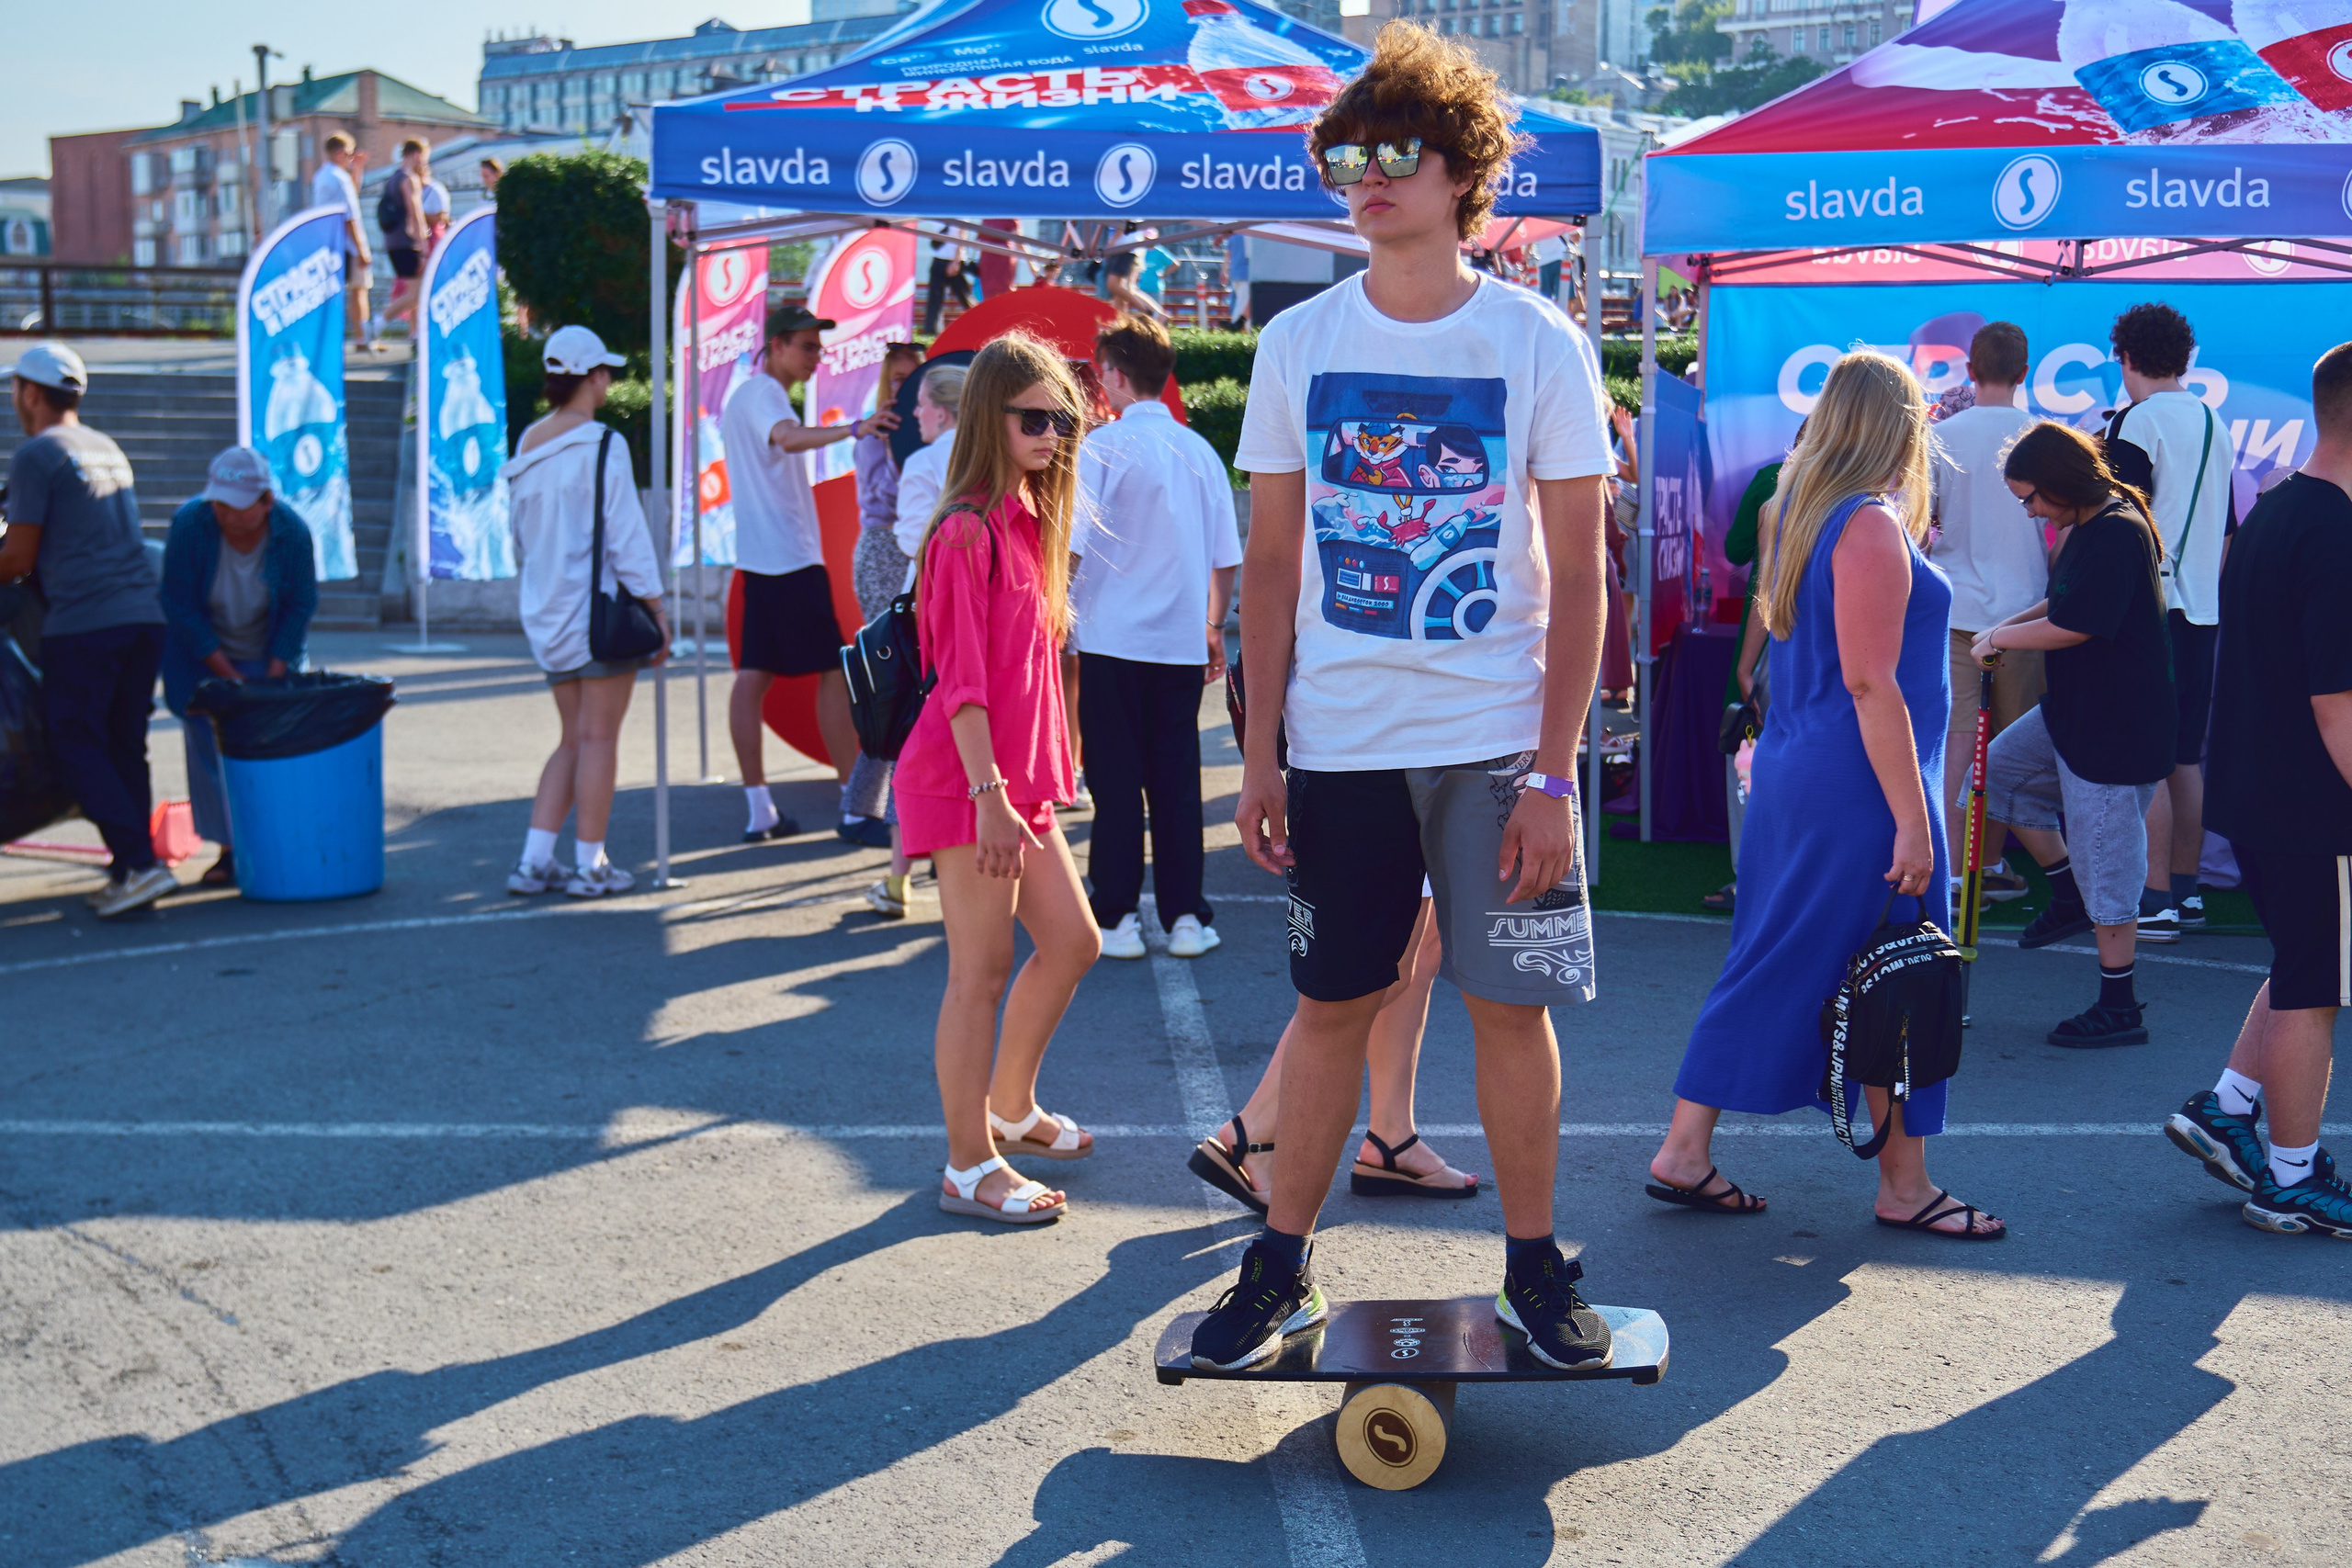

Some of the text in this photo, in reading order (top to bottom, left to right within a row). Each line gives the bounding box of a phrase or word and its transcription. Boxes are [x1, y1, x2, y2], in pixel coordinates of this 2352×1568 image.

[1025, 55, 1075, 66] ВОДА
[1083, 42, 1144, 55] slavda
[770, 67, 1137, 103] СТРАСТЬ
[855, 83, 1182, 112] К ЖИЗНИ
[700, 146, 831, 186] slavda
[943, 150, 1069, 188] slavda
[1181, 154, 1306, 192] slavda
[1784, 176, 1925, 220] slavda
[2125, 166, 2271, 209] slavda
[1487, 910, 1588, 940] SUMME
[1830, 1082, 1838, 1115] EDITION
[1837, 1084, 1846, 1116] LIMITED
